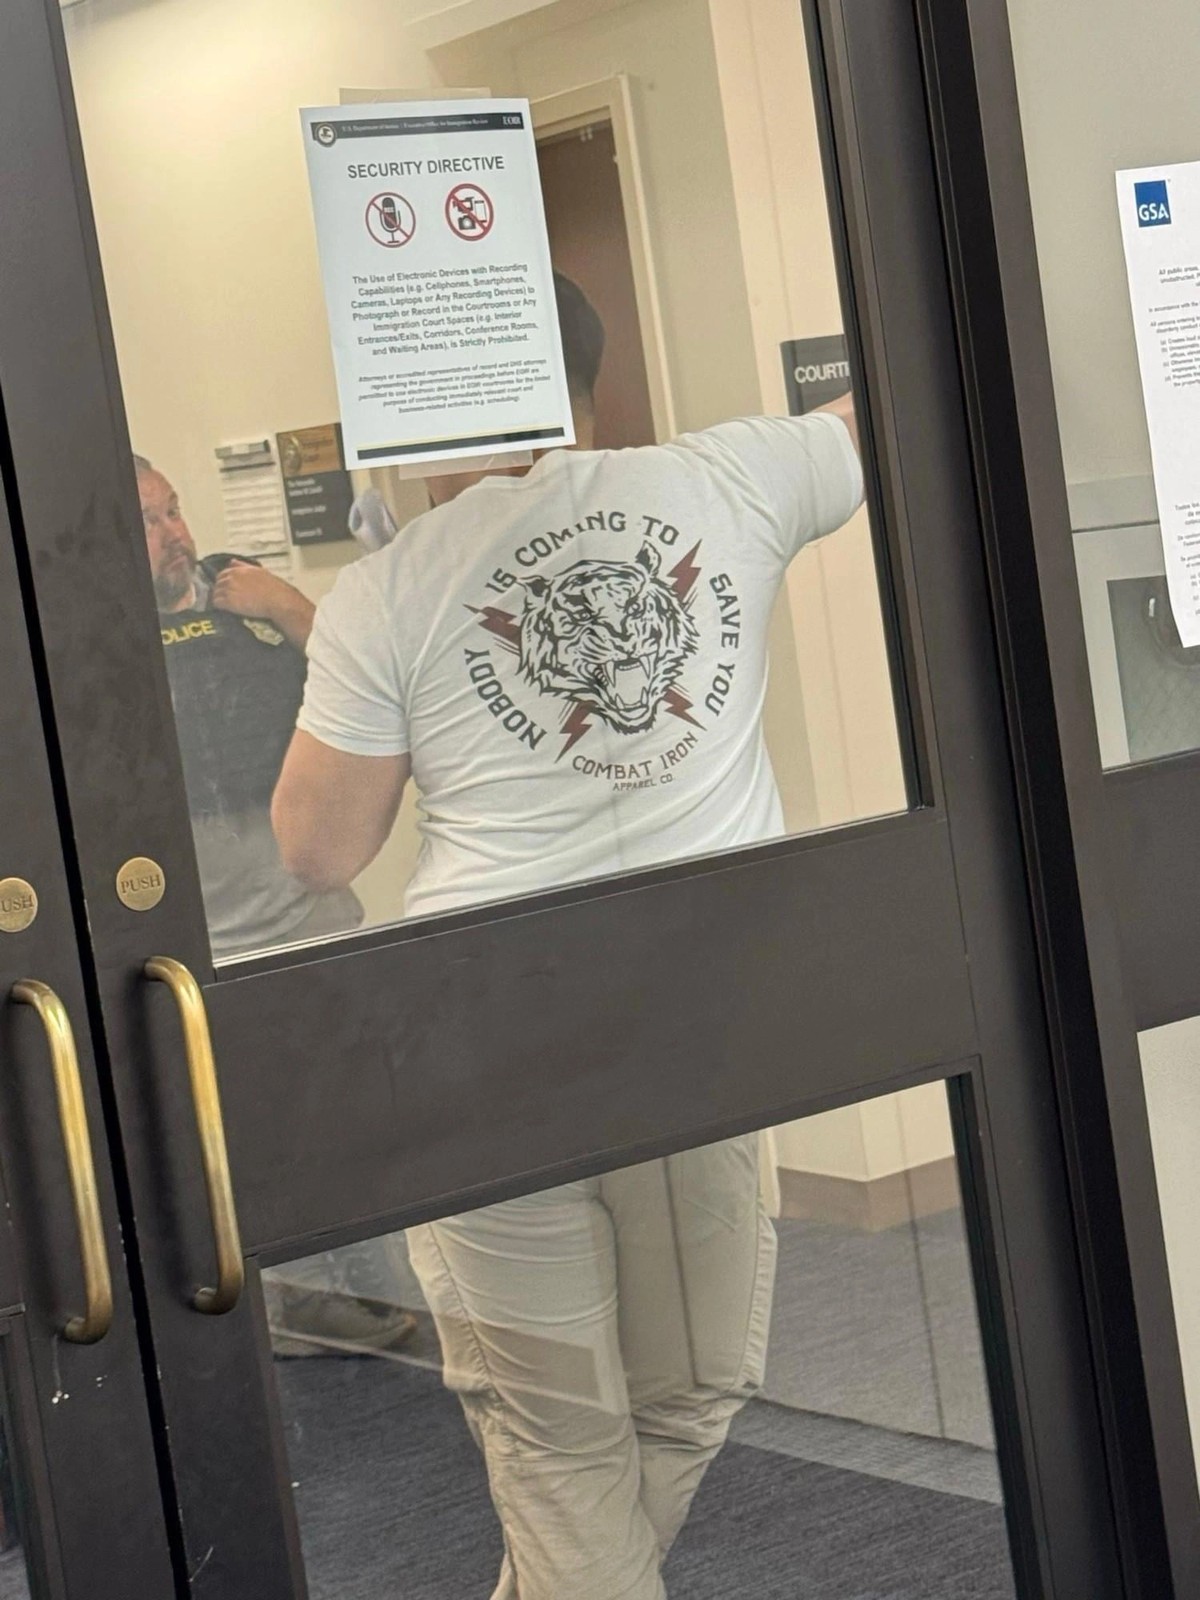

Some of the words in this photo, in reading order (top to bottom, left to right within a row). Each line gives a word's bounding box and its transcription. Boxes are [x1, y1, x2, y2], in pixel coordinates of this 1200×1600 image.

[347, 161, 423, 179] SECURITY
[427, 156, 505, 174] DIRECTIVE
[1138, 203, 1169, 221] GSA
[352, 276, 368, 284] The
[369, 275, 385, 283] Use
[387, 273, 395, 281] of
[397, 271, 437, 281] Electronic
[439, 269, 469, 277] Devices
[471, 266, 487, 274] with
[489, 264, 527, 273] Recording
[351, 300, 389, 309] Cameras,
[390, 297, 422, 306] Laptops
[435, 293, 450, 302] Any
[452, 290, 492, 299] Recording
[493, 287, 526, 296] Devices)
[358, 286, 405, 297] Capabilities
[425, 281, 472, 291] Cellphones,
[473, 277, 526, 286] Smartphones,
[352, 310, 399, 321] Photograph
[411, 306, 440, 316] Record
[465, 302, 511, 311] Courtrooms
[522, 298, 537, 307] Any
[373, 321, 420, 331] Immigration
[422, 318, 445, 327] Court
[446, 315, 475, 325] Spaces
[494, 311, 522, 320] Interior
[358, 333, 422, 345] Entrances/Exits,
[423, 329, 464, 339] Corridors,
[465, 325, 509, 335] Conference
[510, 322, 539, 331] Rooms,
[372, 347, 387, 355] and
[388, 345, 419, 354] Waiting
[420, 341, 449, 351] Areas),
[450, 340, 458, 348] is
[459, 338, 486, 347] Strictly
[488, 333, 530, 344] Prohibited.
[515, 510, 626, 567] COMING
[642, 515, 680, 546] TO
[485, 568, 517, 594] IS
[709, 573, 741, 649] SAVE
[161, 619, 217, 645] OLICE
[464, 648, 547, 751] NOBODY
[705, 663, 736, 717] YOU
[572, 755, 652, 780] COMBAT
[660, 731, 699, 770] IRON
[612, 779, 657, 792] APPAREL
[121, 874, 162, 894] PUSH
[1, 894, 34, 913] USH
